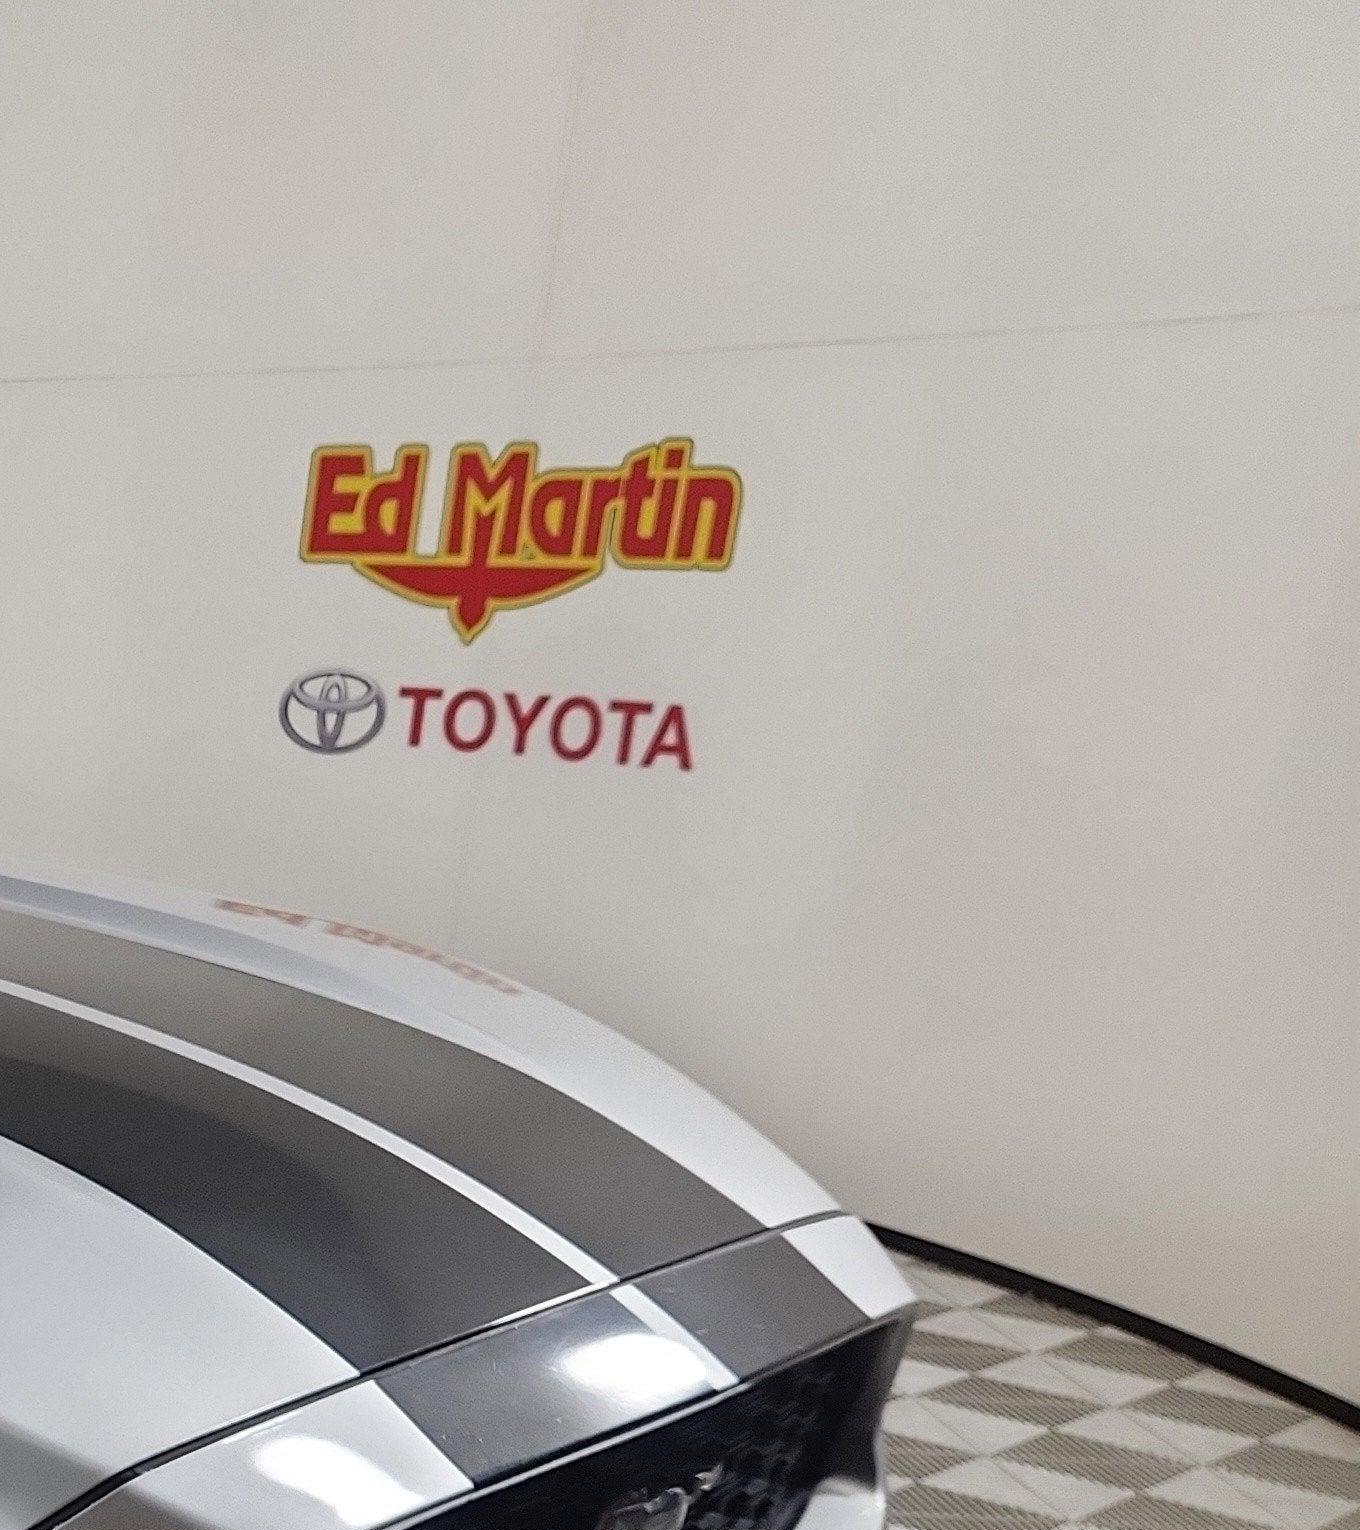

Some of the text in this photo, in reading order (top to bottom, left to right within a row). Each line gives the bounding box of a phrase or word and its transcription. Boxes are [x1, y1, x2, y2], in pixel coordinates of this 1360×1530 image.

[299, 437, 743, 571] Ed Martin
[398, 685, 694, 771] TOYOTA
